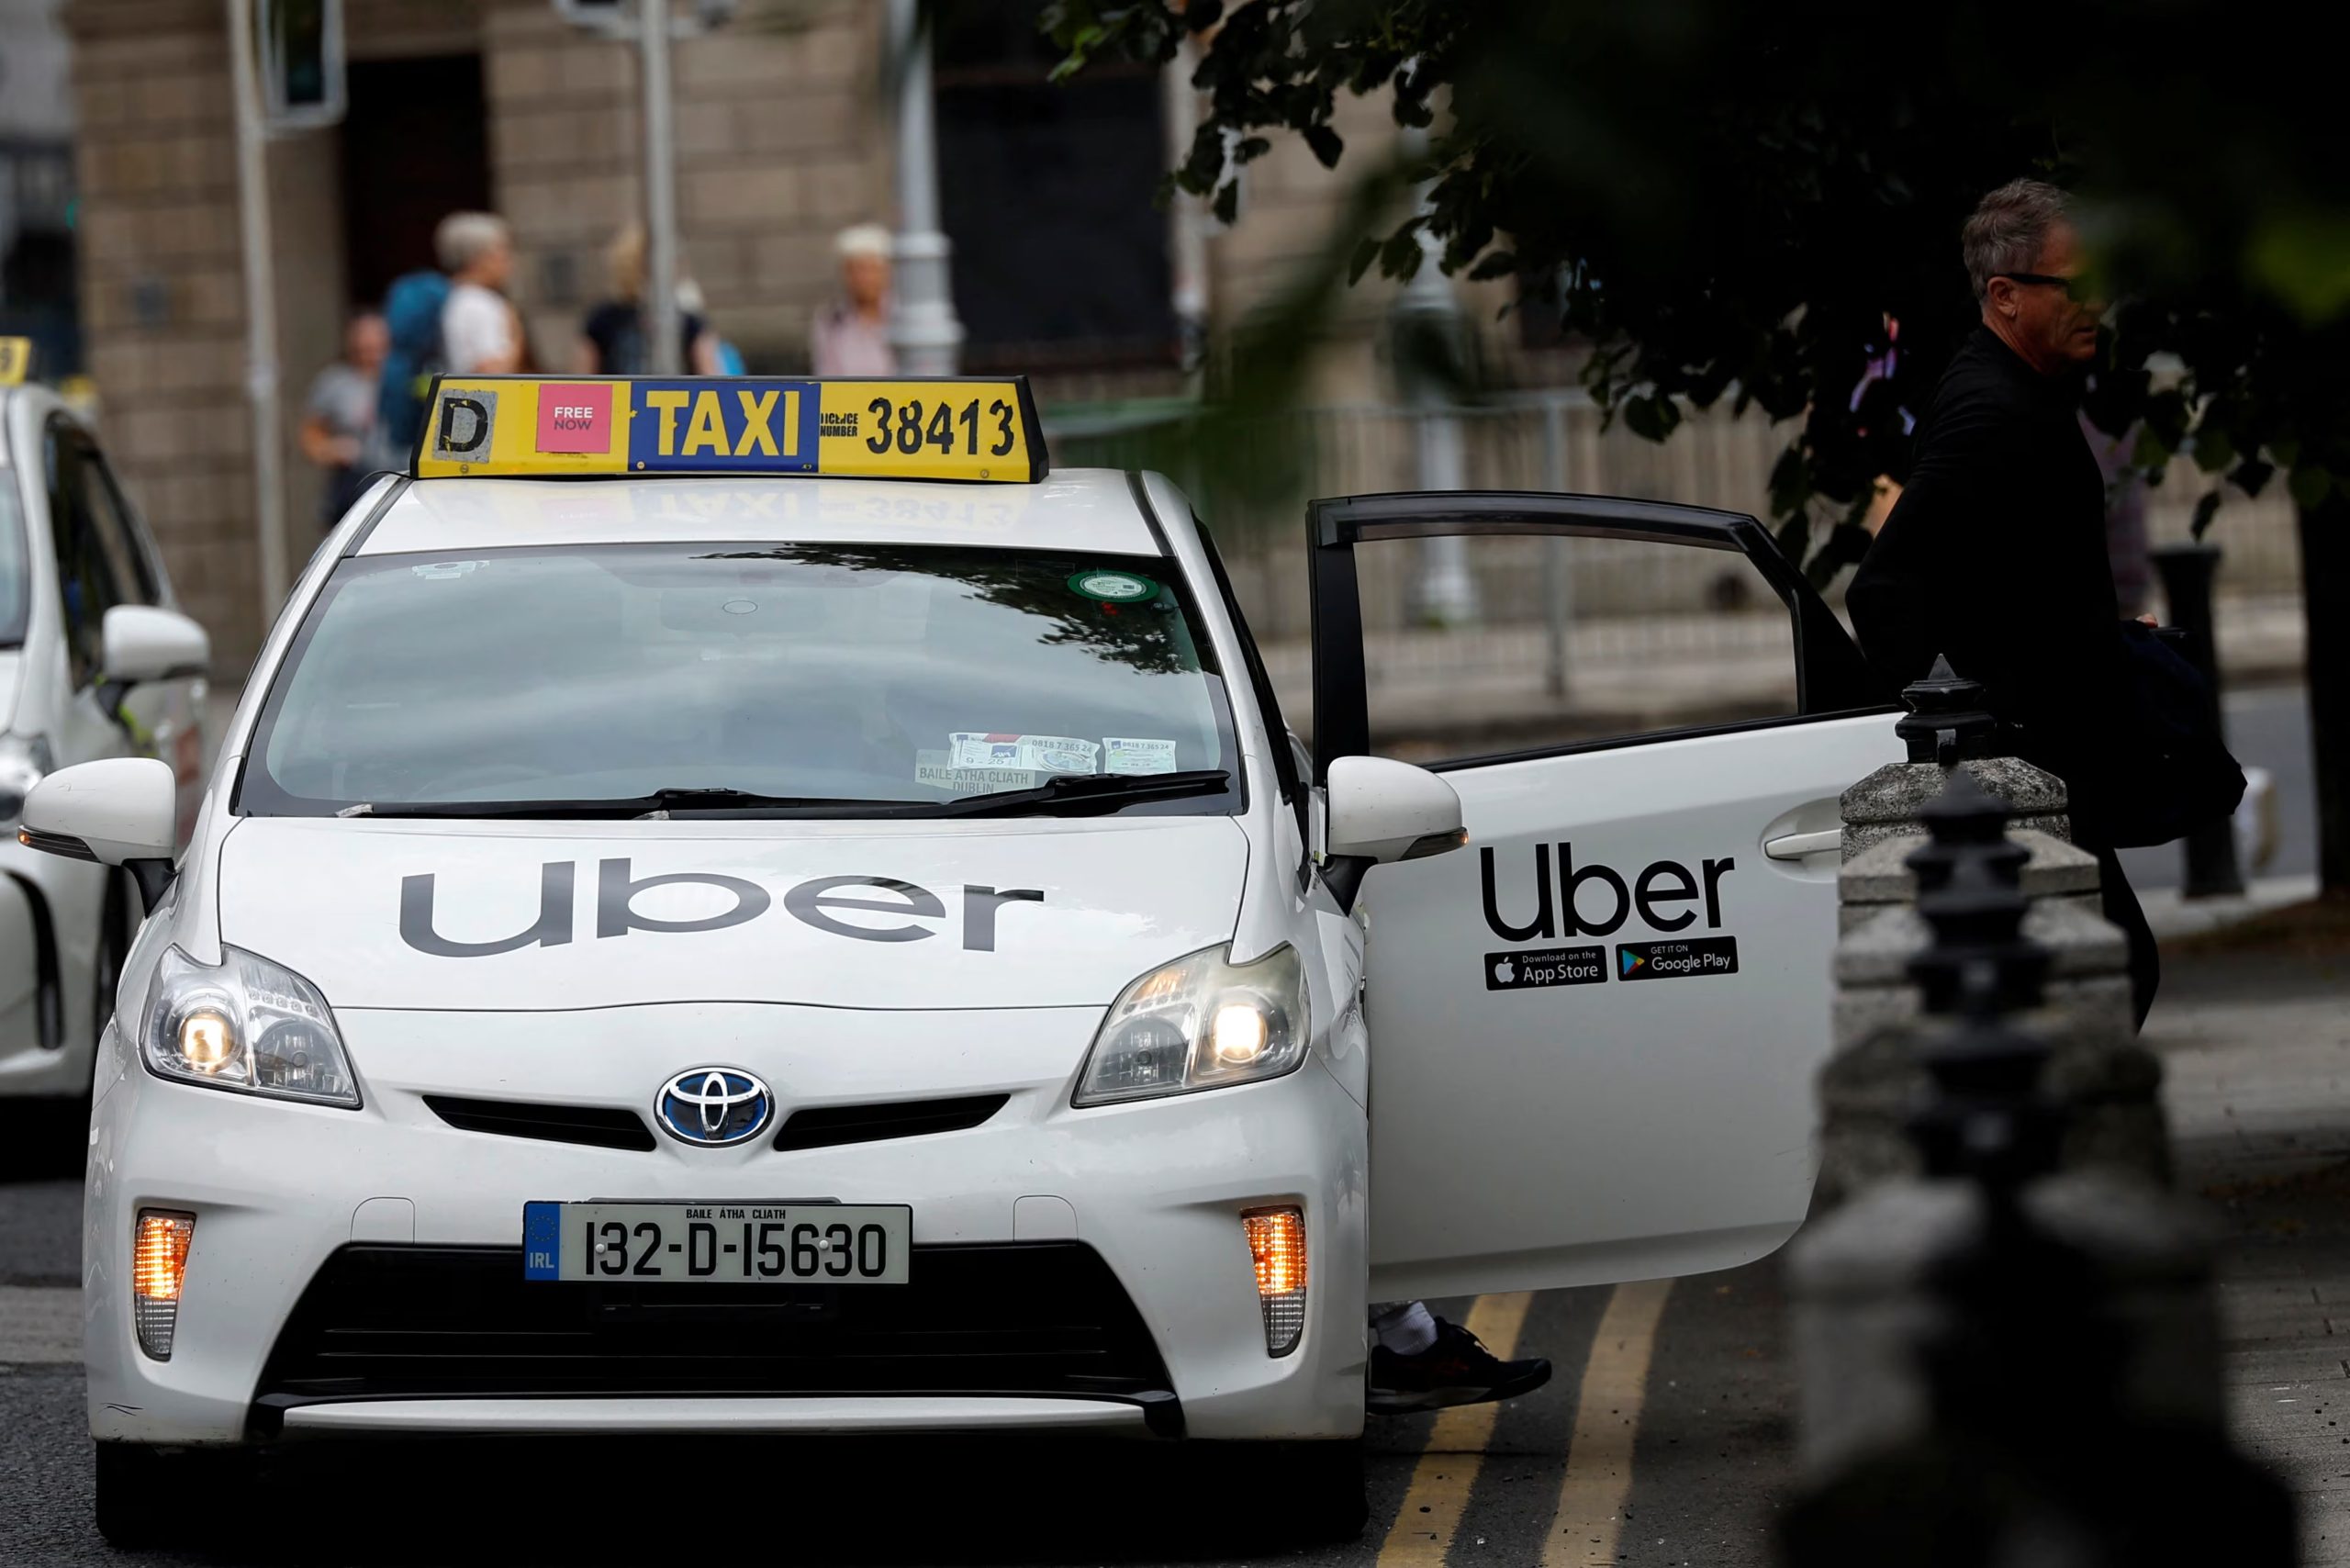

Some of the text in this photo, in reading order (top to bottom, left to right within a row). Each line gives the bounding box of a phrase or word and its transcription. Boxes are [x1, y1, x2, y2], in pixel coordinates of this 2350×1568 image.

[554, 407, 593, 419] FREE
[438, 398, 488, 453] D
[554, 419, 592, 431] NOW
[646, 390, 800, 455] TAXI
[820, 425, 857, 437] NUMBER
[867, 397, 1014, 456] 38413
[1032, 739, 1055, 749] 0818
[920, 767, 953, 779] BAILE
[989, 771, 1029, 784] CLIATH
[953, 781, 994, 793] DUBLIN
[1480, 842, 1735, 942] Uber
[398, 857, 1045, 958] Uber
[1522, 952, 1566, 963] Download
[1582, 951, 1596, 959] the
[1651, 946, 1666, 954] GET
[1652, 953, 1730, 972] Google Play
[1524, 964, 1598, 984] App Store
[686, 1206, 786, 1219] BAILE ÁTHA CLIATH
[586, 1221, 887, 1277] 132-D-15630
[529, 1252, 555, 1269] IRL
